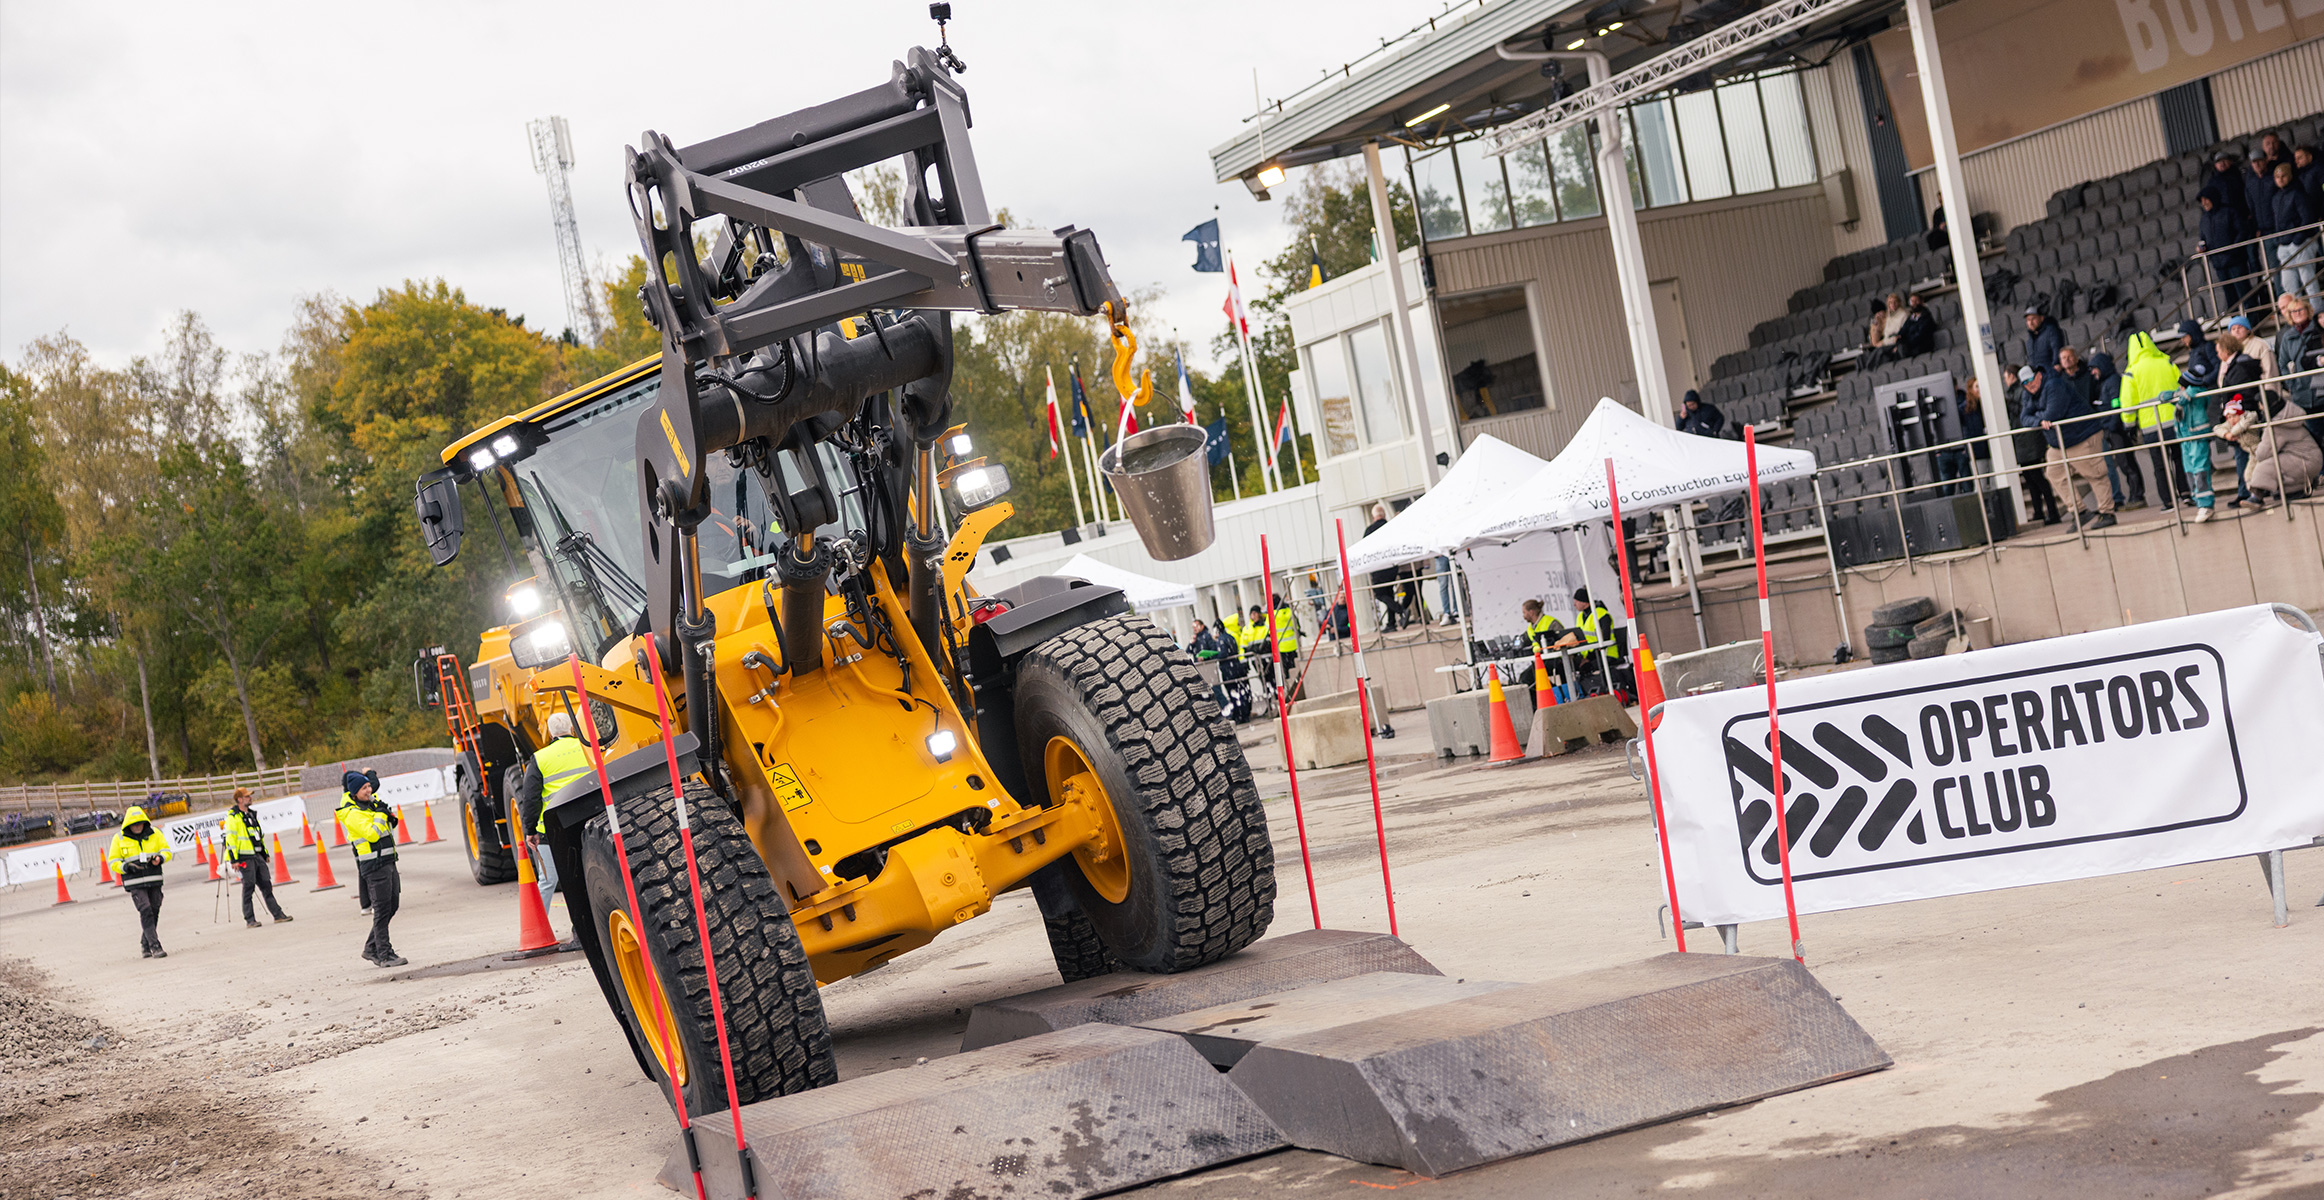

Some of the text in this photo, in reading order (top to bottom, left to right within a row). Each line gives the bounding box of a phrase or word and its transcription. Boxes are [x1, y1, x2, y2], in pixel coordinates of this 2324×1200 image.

[570, 378, 661, 428] VOLV
[1588, 461, 1796, 510] Volo Construction Equment
[1919, 664, 2209, 766] OPERATORS
[1933, 764, 2057, 839] CLUB
